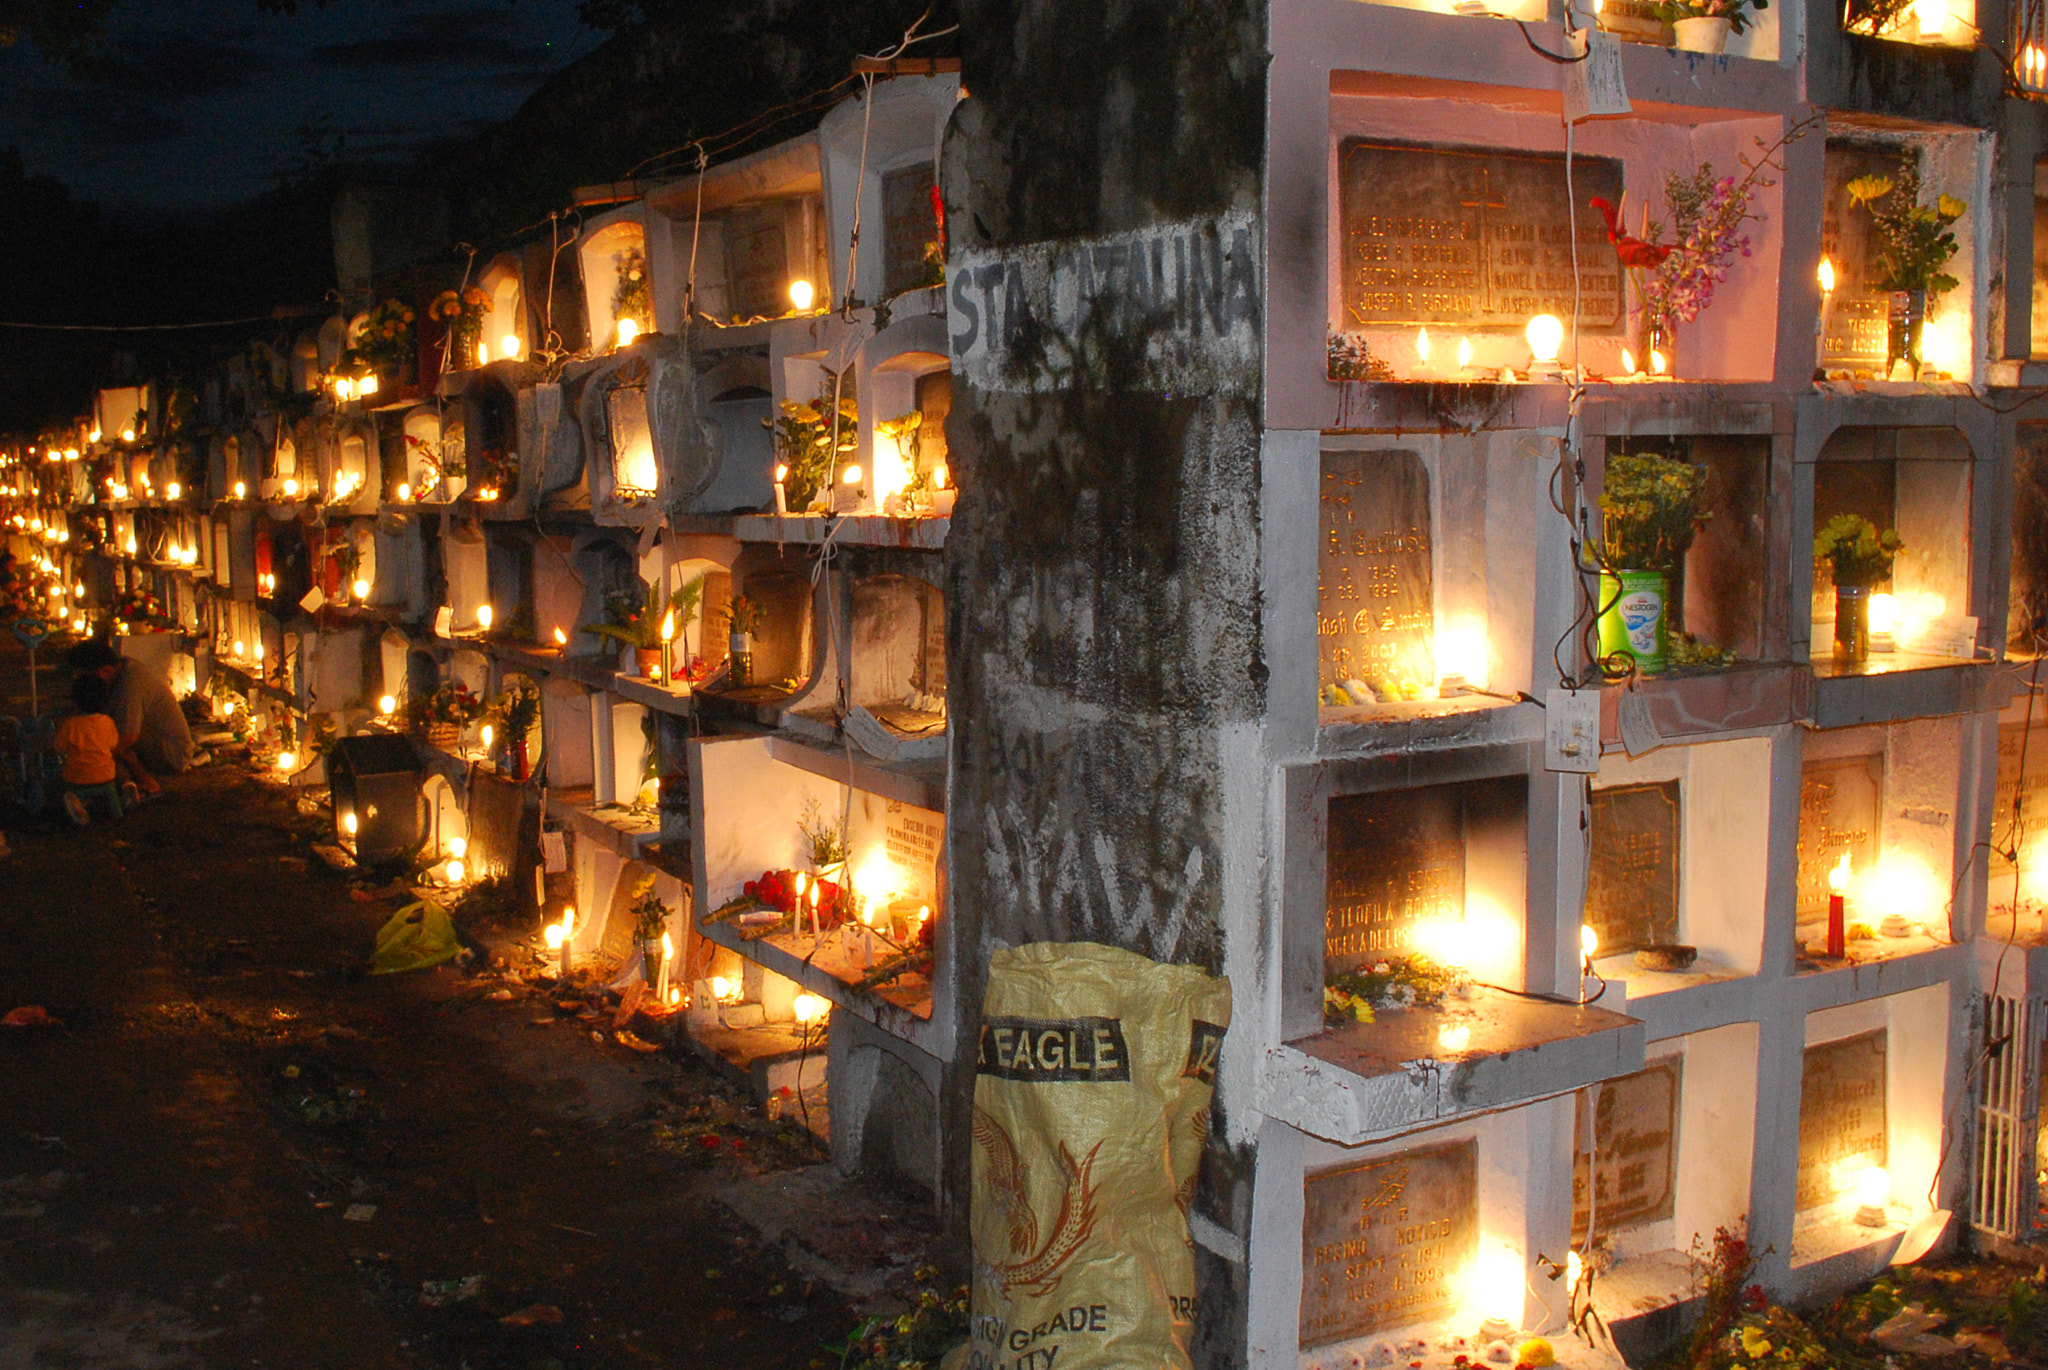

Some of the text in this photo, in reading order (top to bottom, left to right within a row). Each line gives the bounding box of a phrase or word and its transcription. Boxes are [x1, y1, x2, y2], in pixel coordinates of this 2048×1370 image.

[952, 259, 1036, 356] STA
[1360, 292, 1403, 311] JOSEPH
[1625, 603, 1658, 612] NESTOGEN
[994, 1027, 1119, 1070] EAGLE
[1396, 1218, 1451, 1247] NOVICIO
[1009, 1304, 1107, 1351] GRADE
